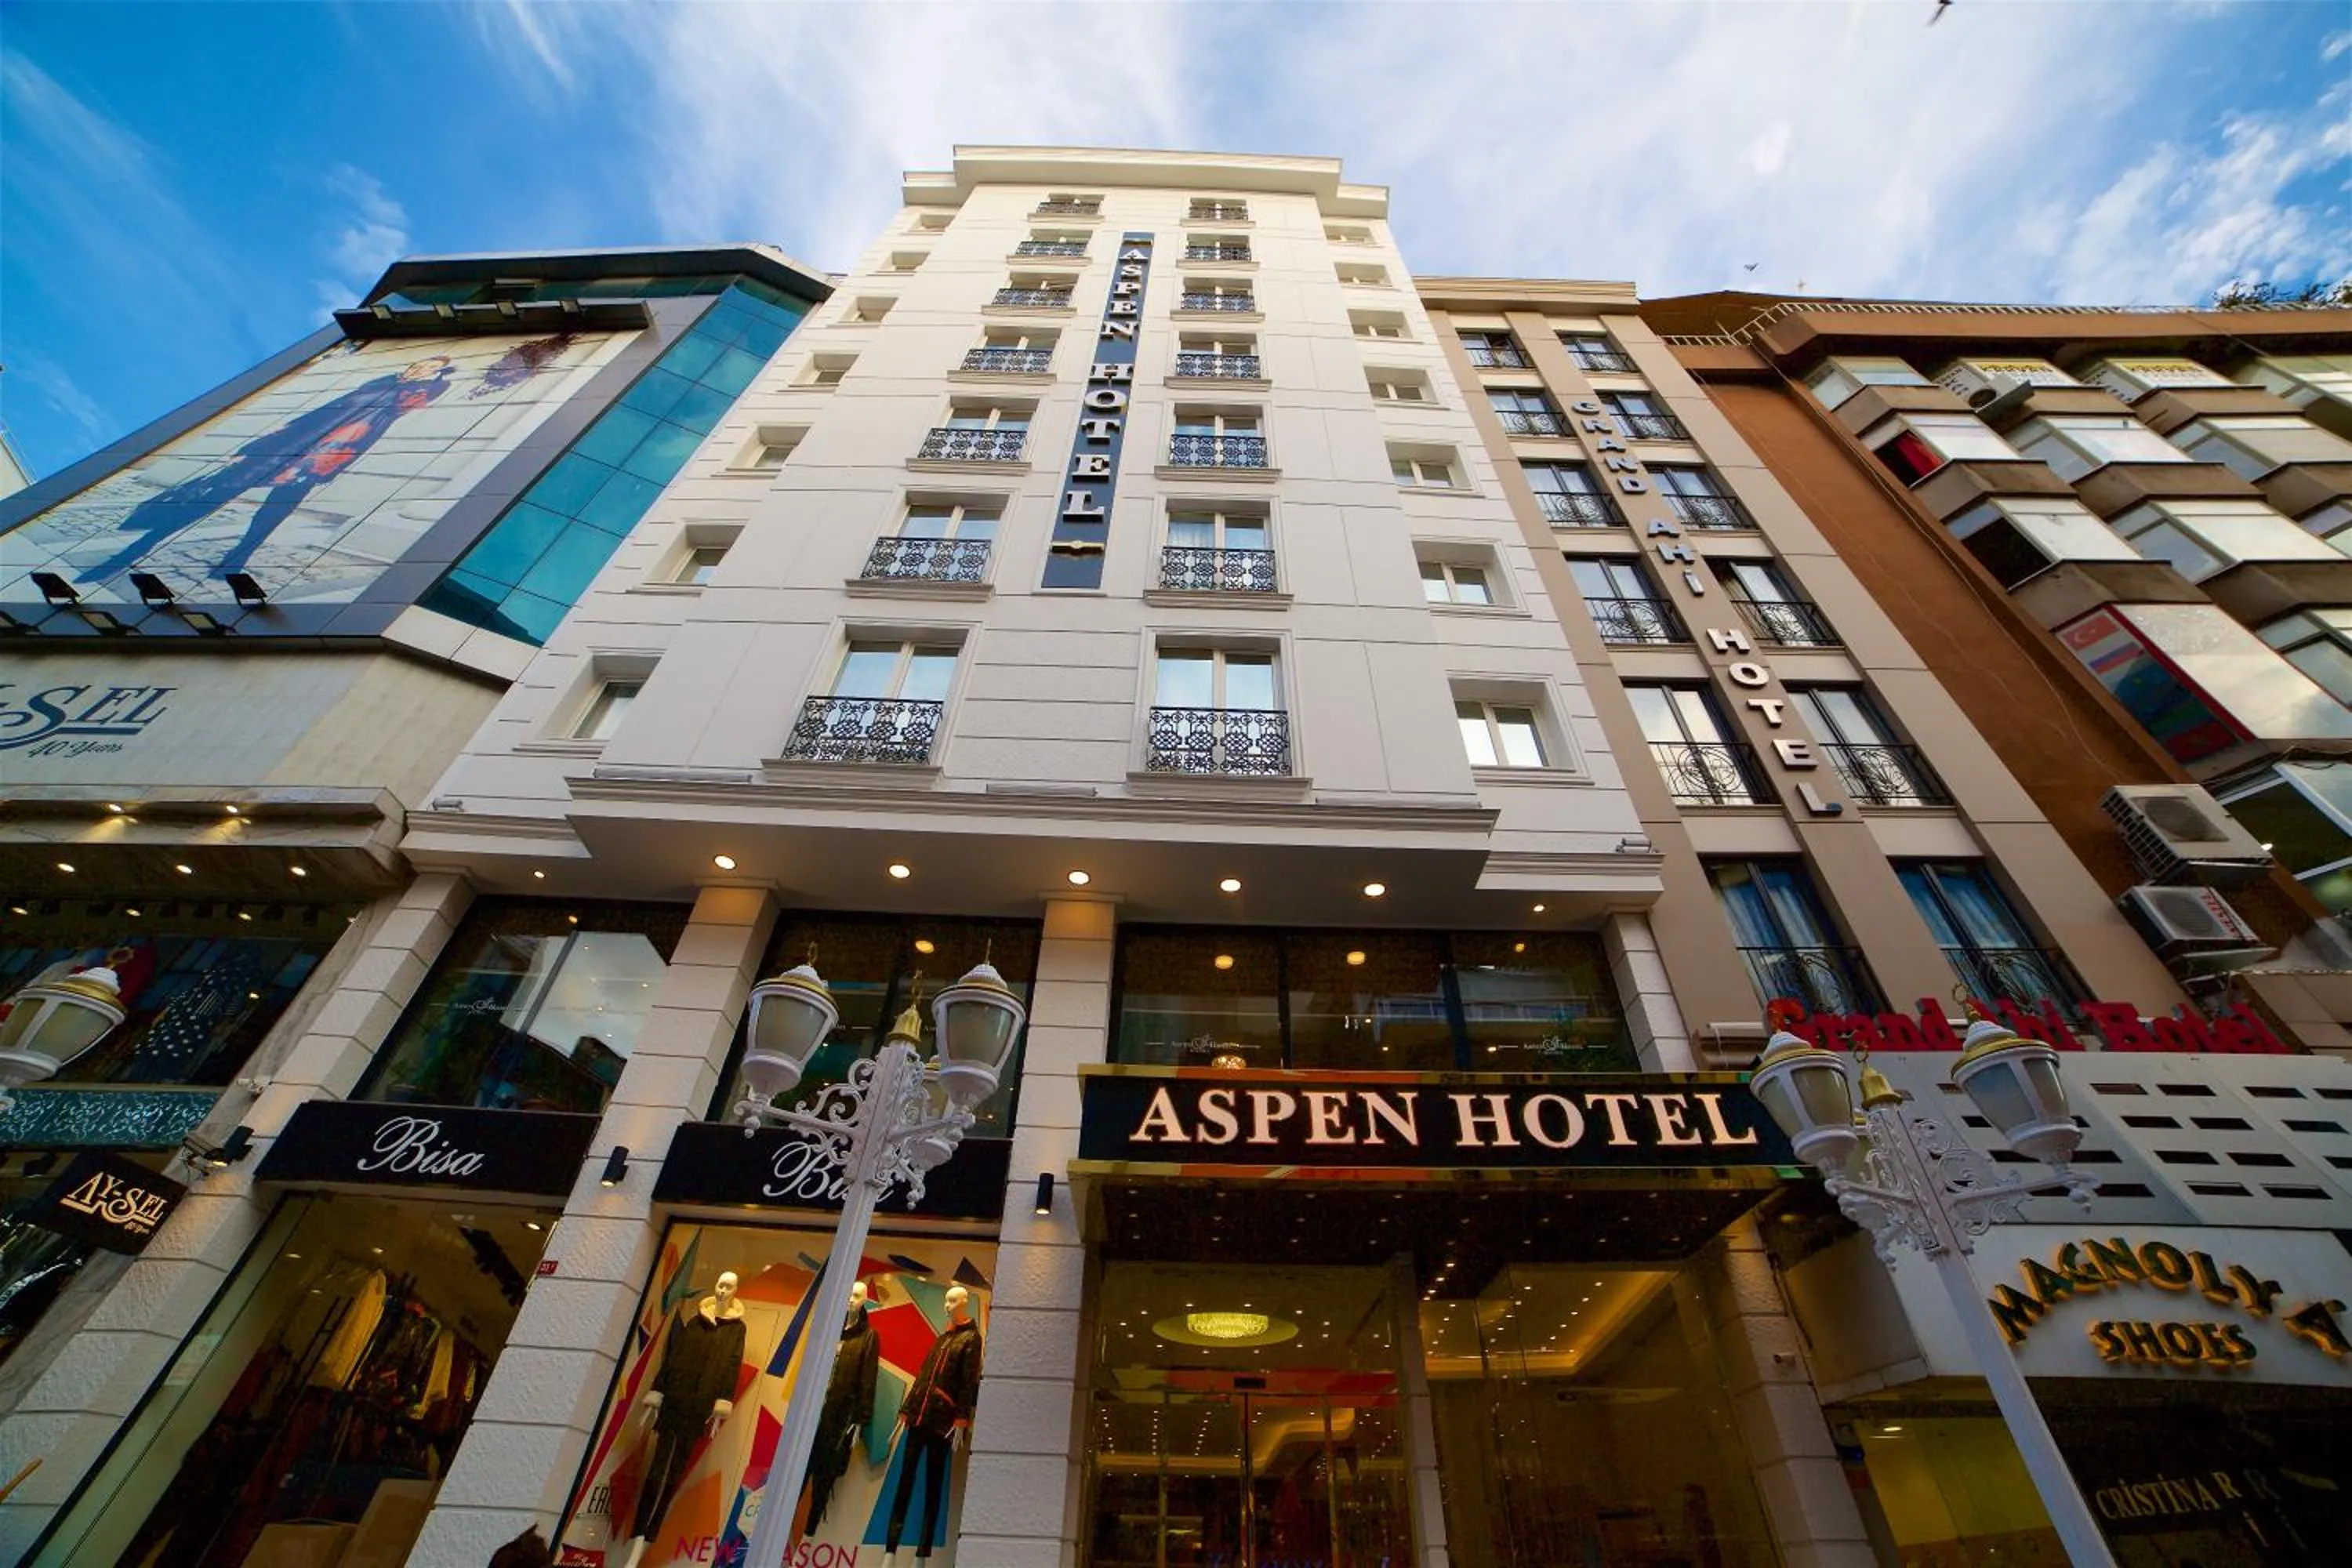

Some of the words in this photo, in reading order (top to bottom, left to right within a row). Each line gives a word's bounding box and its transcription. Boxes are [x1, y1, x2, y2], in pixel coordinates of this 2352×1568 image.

[1101, 248, 1149, 340] ASPEN
[1062, 362, 1134, 524] HOTEL
[1571, 400, 1648, 495] GRAND
[1706, 627, 1844, 817] HOTEL
[357, 1116, 485, 1176] Bisa
[1128, 1086, 1418, 1146] ASPEN
[1448, 1093, 1759, 1149] HOTEL
[2087, 1319, 2258, 1367] SHOES
[782, 1541, 859, 1568] ASON
